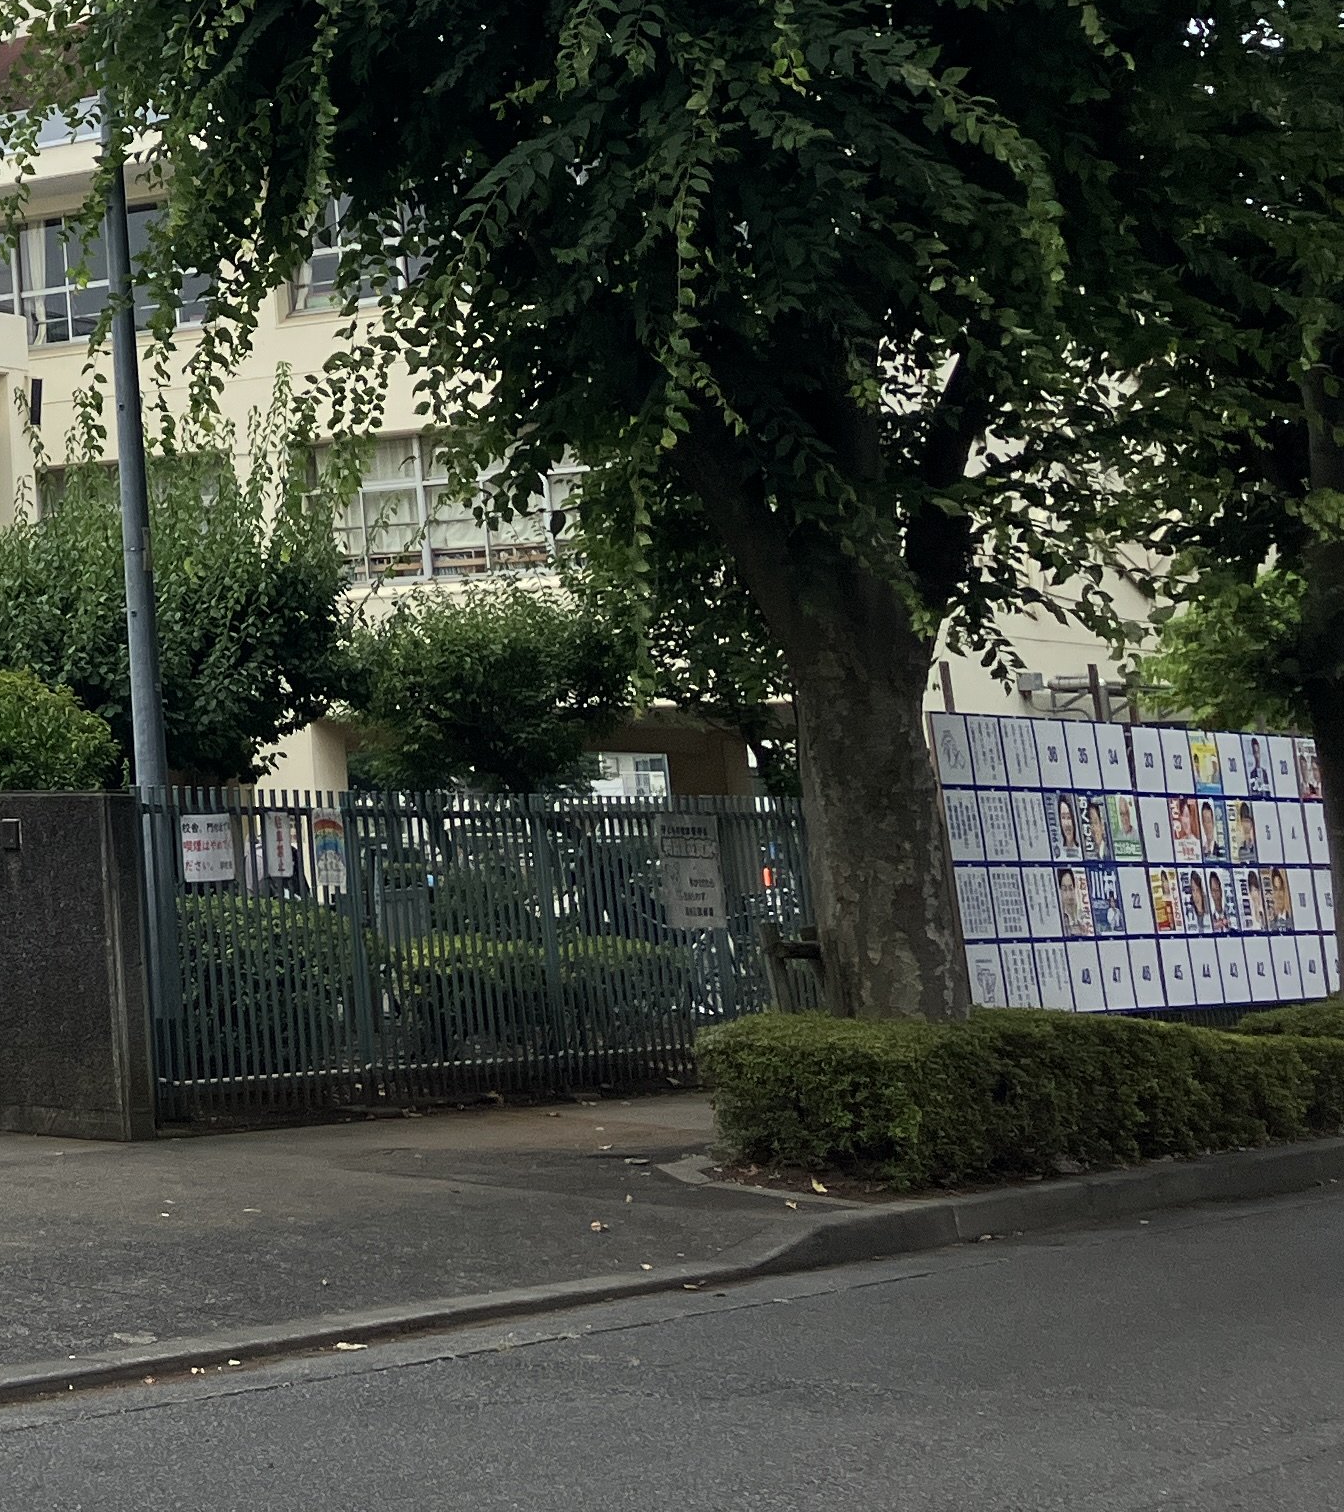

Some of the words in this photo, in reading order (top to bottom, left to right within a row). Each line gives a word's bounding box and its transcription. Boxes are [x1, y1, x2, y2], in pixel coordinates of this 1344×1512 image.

[1047, 746, 1058, 763] 36
[1078, 747, 1088, 764] 35
[1108, 749, 1119, 765] 34
[1143, 752, 1154, 768] 33
[1172, 754, 1183, 770] 32
[1131, 892, 1142, 909] 22
